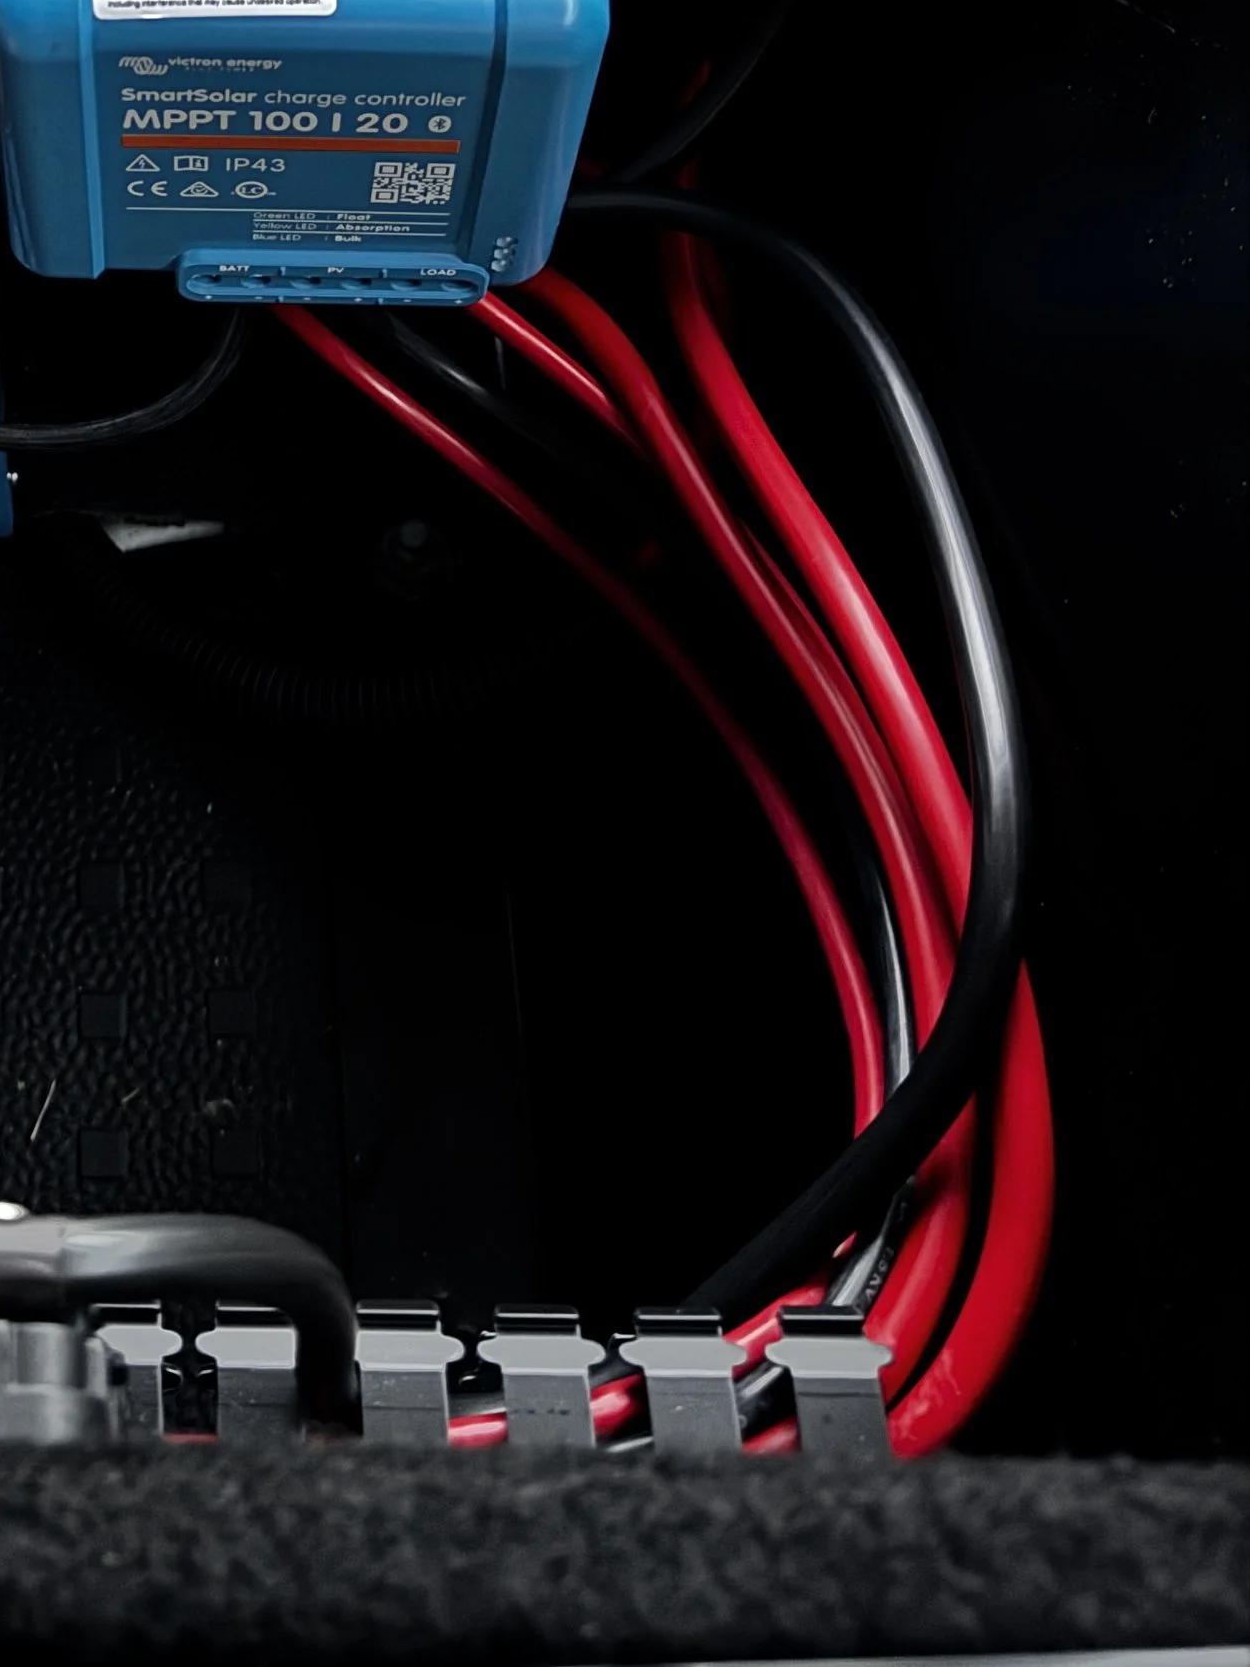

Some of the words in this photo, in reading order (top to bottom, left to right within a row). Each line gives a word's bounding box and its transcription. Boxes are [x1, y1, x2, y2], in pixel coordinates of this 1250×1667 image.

[168, 57, 223, 67] victron
[226, 58, 283, 70] energy
[121, 88, 258, 103] SmartSolar
[264, 90, 347, 108] charge
[354, 92, 466, 107] controller
[122, 109, 237, 131] MPPT
[249, 110, 318, 132] 100
[355, 112, 409, 134] 20
[226, 157, 286, 172] IP43
[253, 212, 290, 220] Green
[294, 212, 316, 220] LED
[336, 213, 371, 221] Float
[334, 224, 410, 233] Absorption
[420, 268, 457, 276] LOAD
